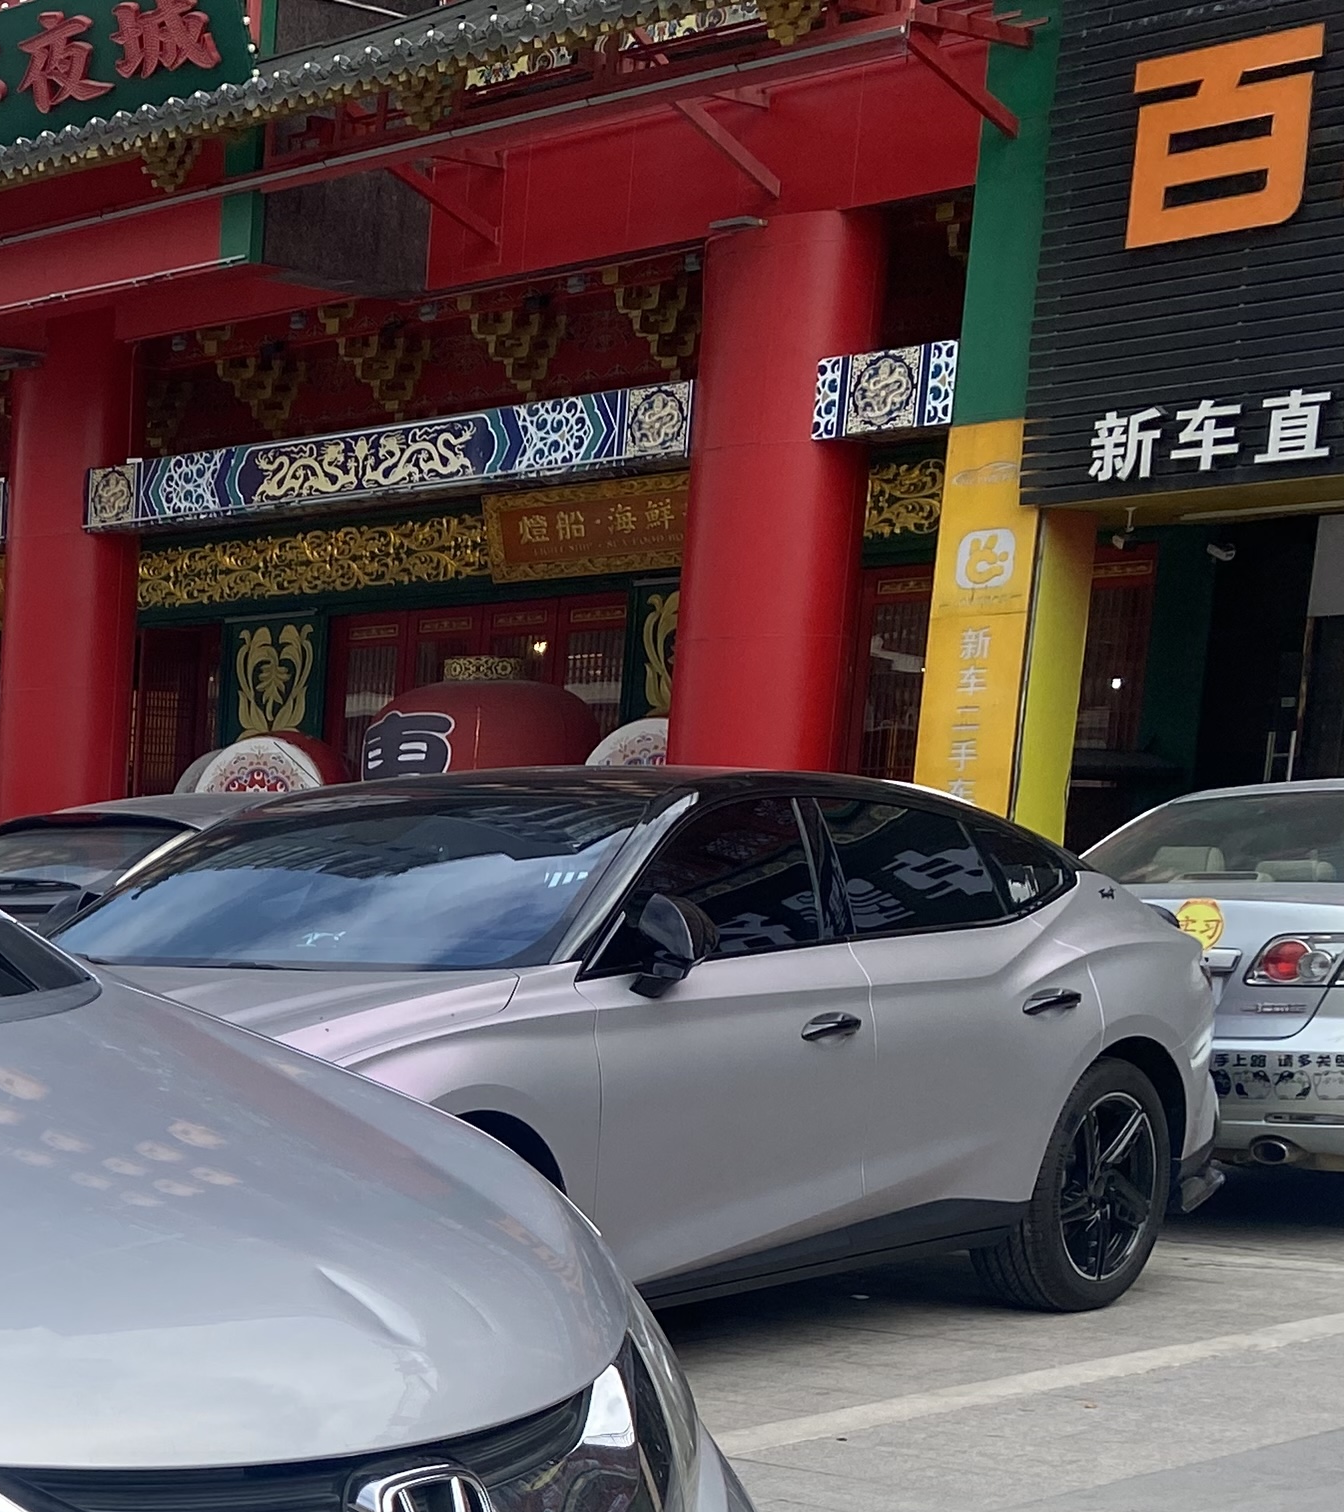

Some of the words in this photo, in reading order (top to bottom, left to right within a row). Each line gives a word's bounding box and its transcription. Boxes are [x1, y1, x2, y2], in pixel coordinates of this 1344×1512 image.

[1124, 23, 1325, 249] 百
[1088, 388, 1331, 482] 新车直
[1178, 915, 1221, 940] 实习
